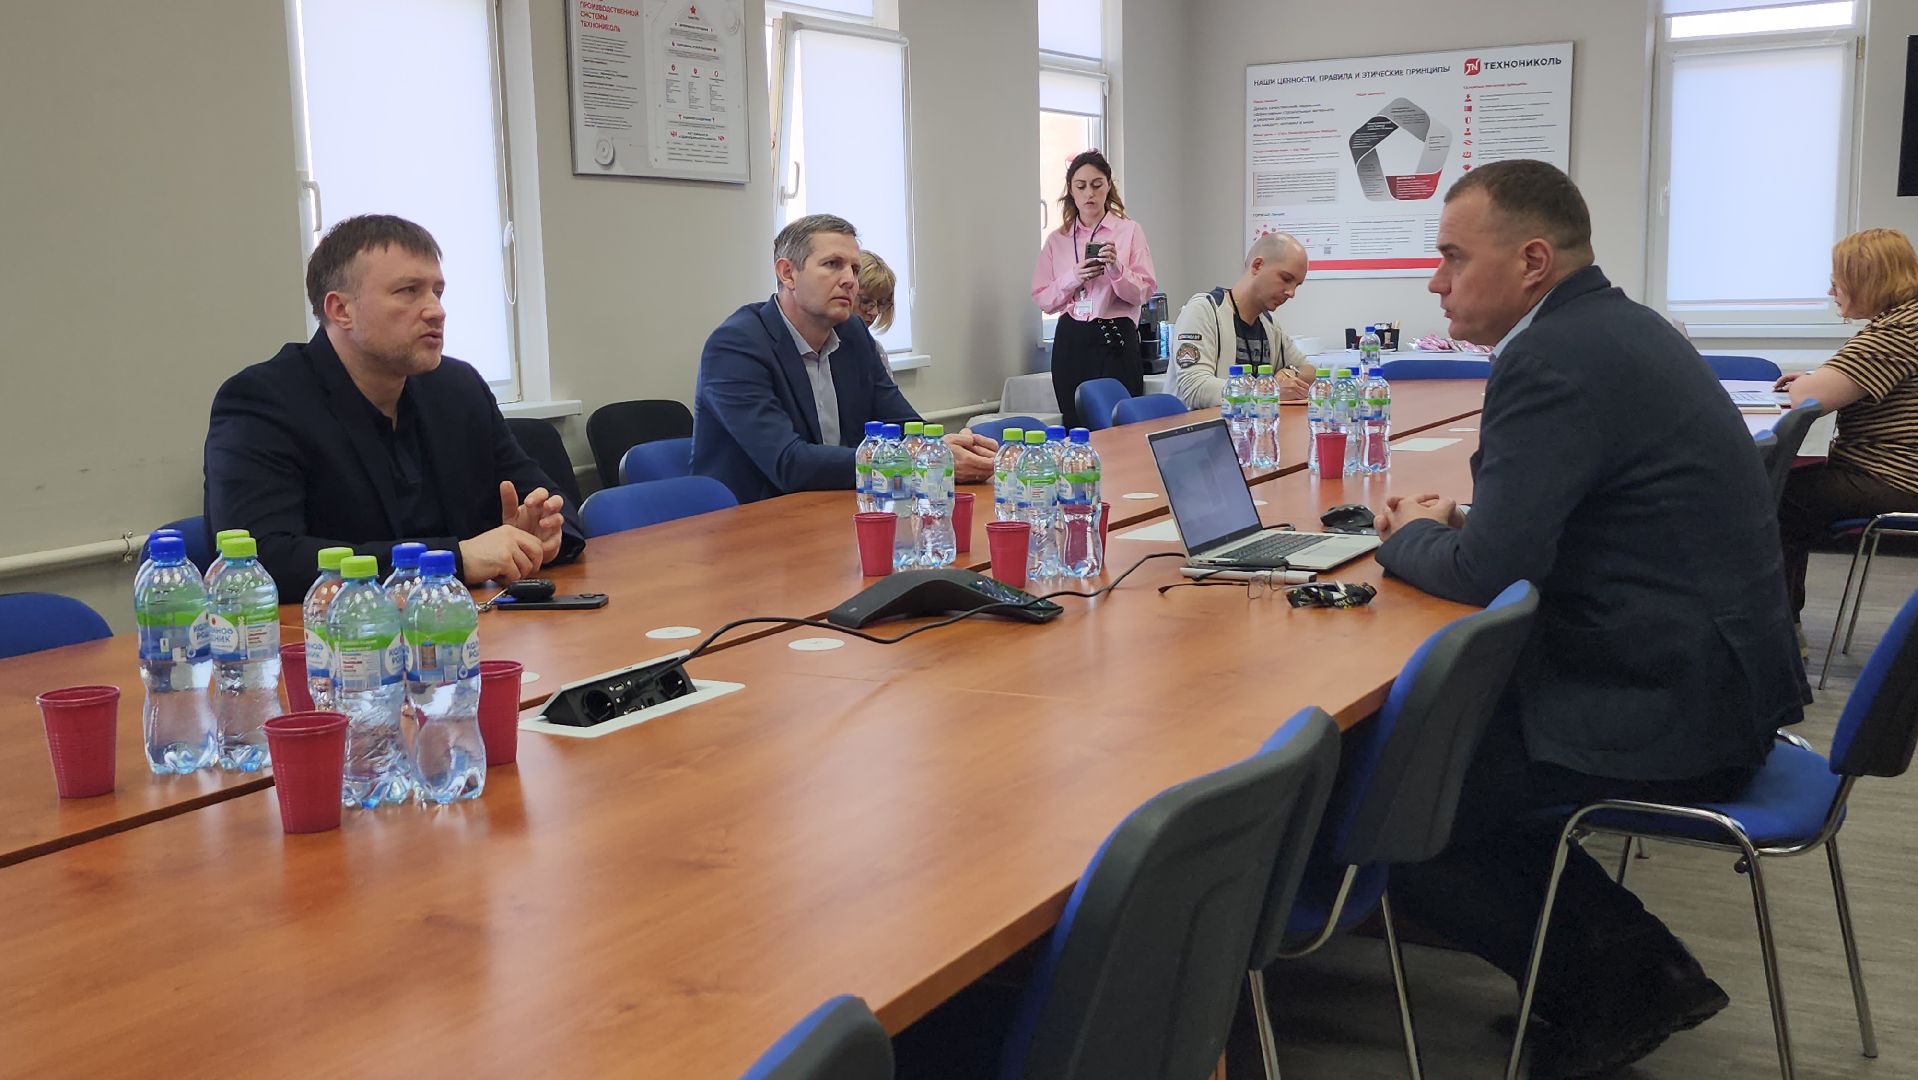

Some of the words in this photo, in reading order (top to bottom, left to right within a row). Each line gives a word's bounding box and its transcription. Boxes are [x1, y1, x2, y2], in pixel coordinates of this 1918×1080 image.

[580, 11, 608, 20] СИСТЕМЫ
[1484, 57, 1562, 70] ТЕХНОНИКОЛЬ
[1319, 72, 1353, 81] ПРАВИЛА
[1362, 69, 1404, 78] ЭТИЧЕСКИЕ
[1406, 66, 1450, 75] ПРИНЦИПЫ
